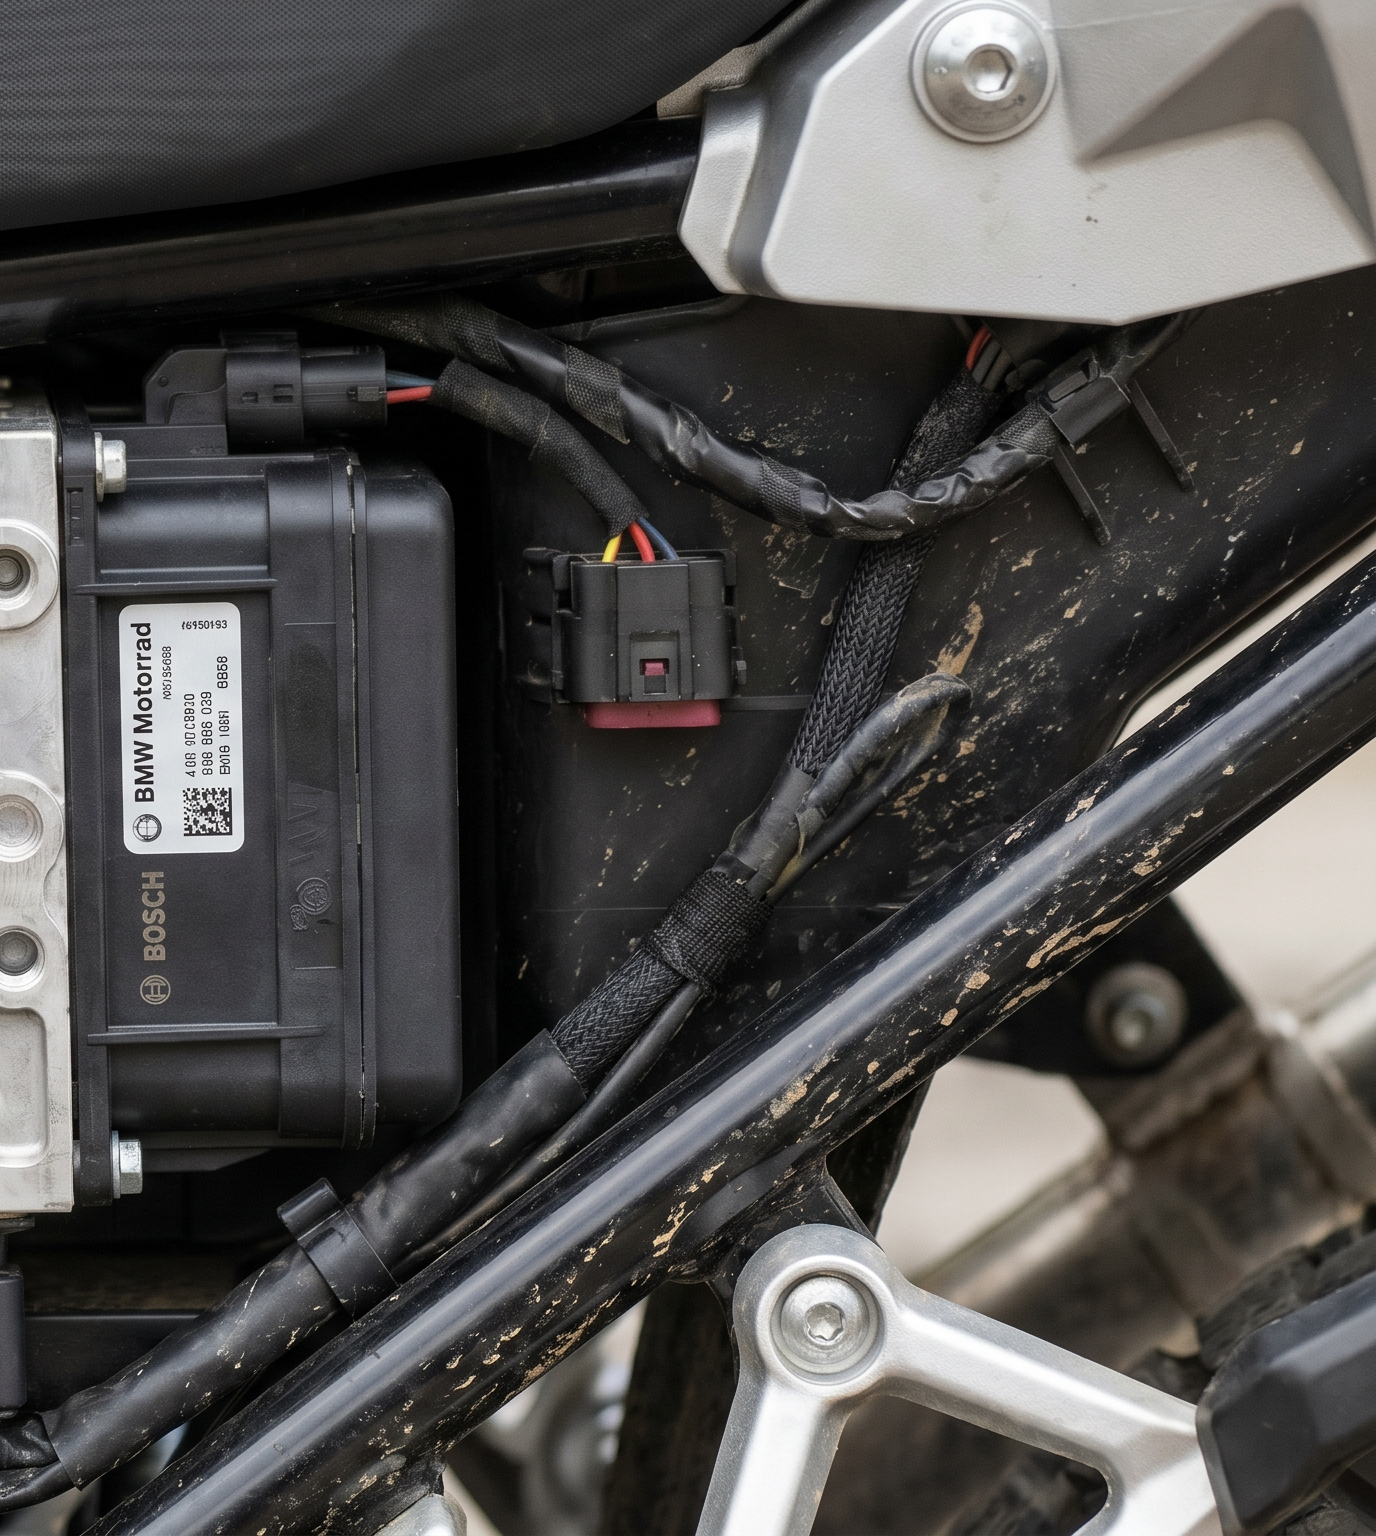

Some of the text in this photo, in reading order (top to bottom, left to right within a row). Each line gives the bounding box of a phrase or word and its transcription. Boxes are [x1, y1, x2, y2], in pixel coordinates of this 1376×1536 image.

[131, 622, 154, 803] BMW Motorrad
[141, 871, 166, 962] BOSCH
